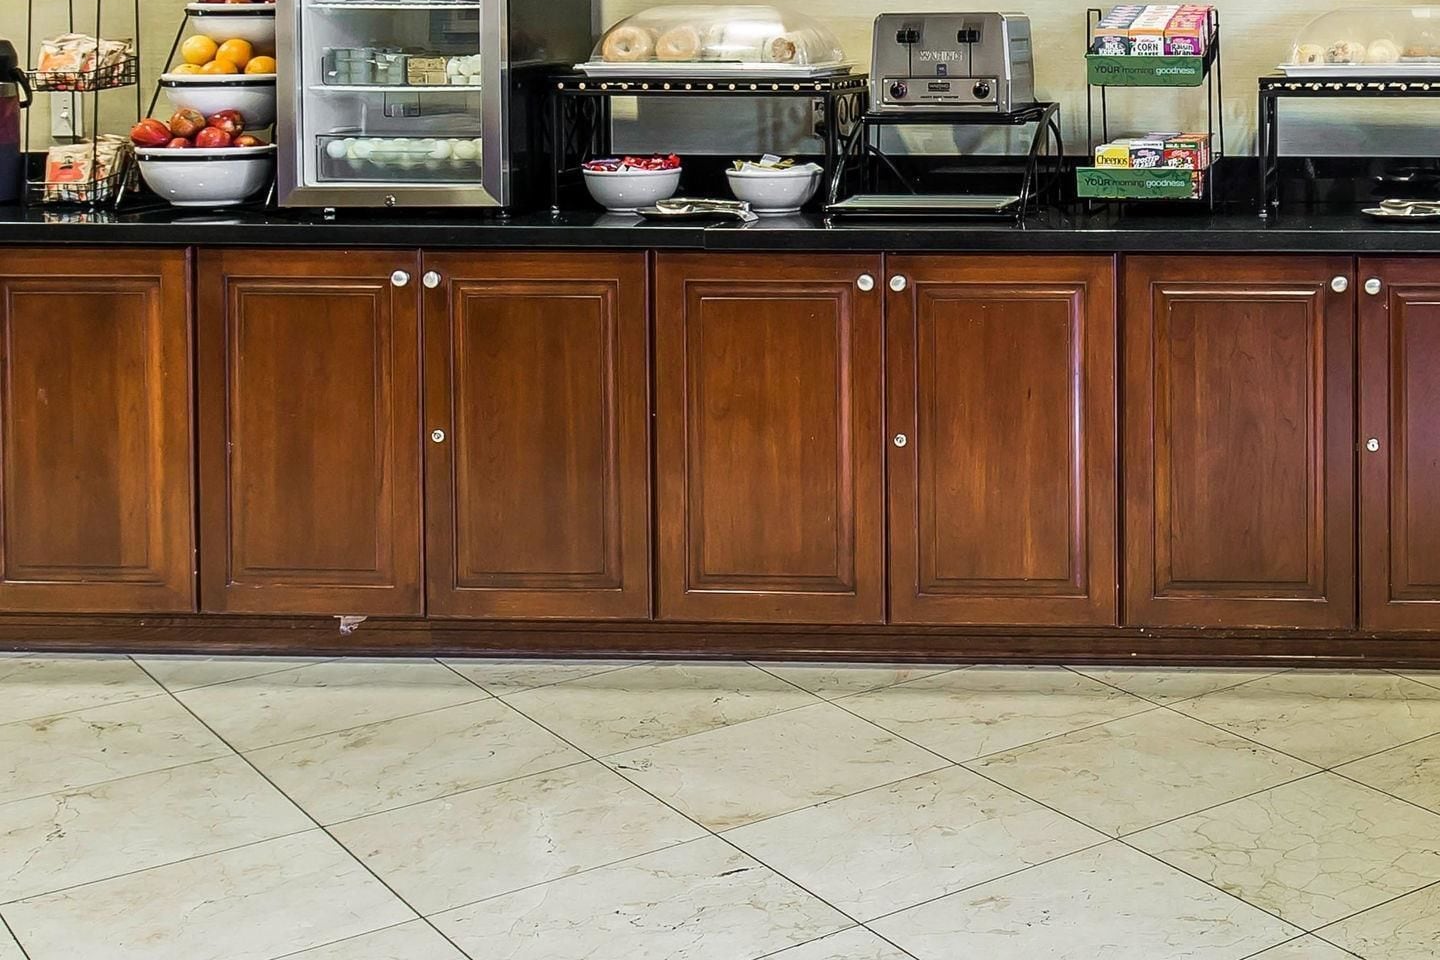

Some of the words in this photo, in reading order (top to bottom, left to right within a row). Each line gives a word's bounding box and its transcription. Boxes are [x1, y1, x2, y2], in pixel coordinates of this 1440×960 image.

[1137, 42, 1158, 51] CORN
[1094, 66, 1120, 74] YOUR
[1122, 66, 1154, 75] morning
[1155, 66, 1195, 75] goodness
[1096, 155, 1128, 165] Cheerios
[1085, 179, 1111, 187] YOUR
[1112, 179, 1144, 187] morning
[1146, 178, 1185, 187] goodness
